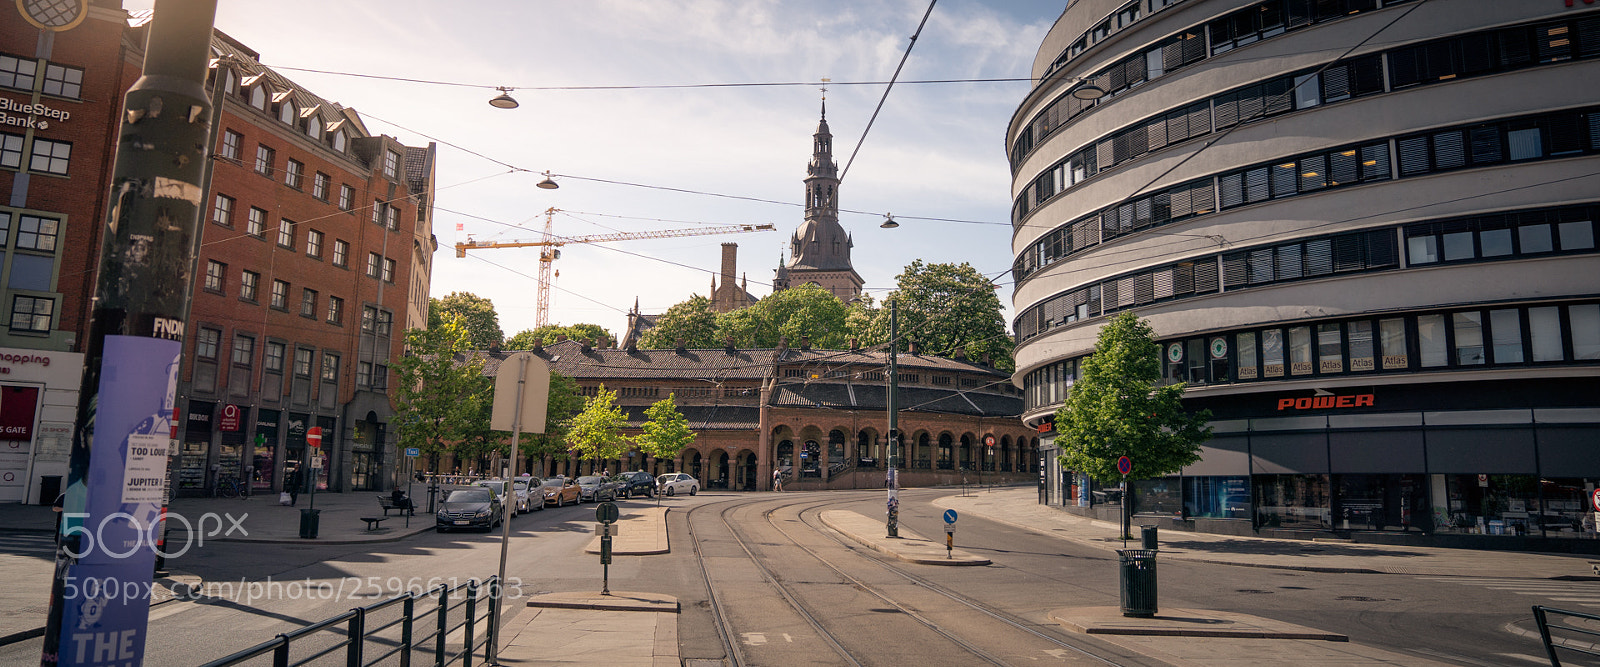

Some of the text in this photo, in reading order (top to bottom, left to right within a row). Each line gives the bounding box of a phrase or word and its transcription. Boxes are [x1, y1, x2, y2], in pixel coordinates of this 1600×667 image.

[0, 97, 70, 122] BlueStep
[0, 112, 36, 128] Bank
[1322, 361, 1342, 369] Atlas
[1352, 358, 1373, 367] Atlas
[1385, 356, 1406, 365] Atlas
[1239, 367, 1257, 375] Atlas
[1293, 363, 1312, 371] Atlas
[1278, 394, 1375, 410] POWER
[5, 426, 26, 434] GATE
[127, 478, 158, 486] JUPITER
[72, 629, 136, 664] THE
